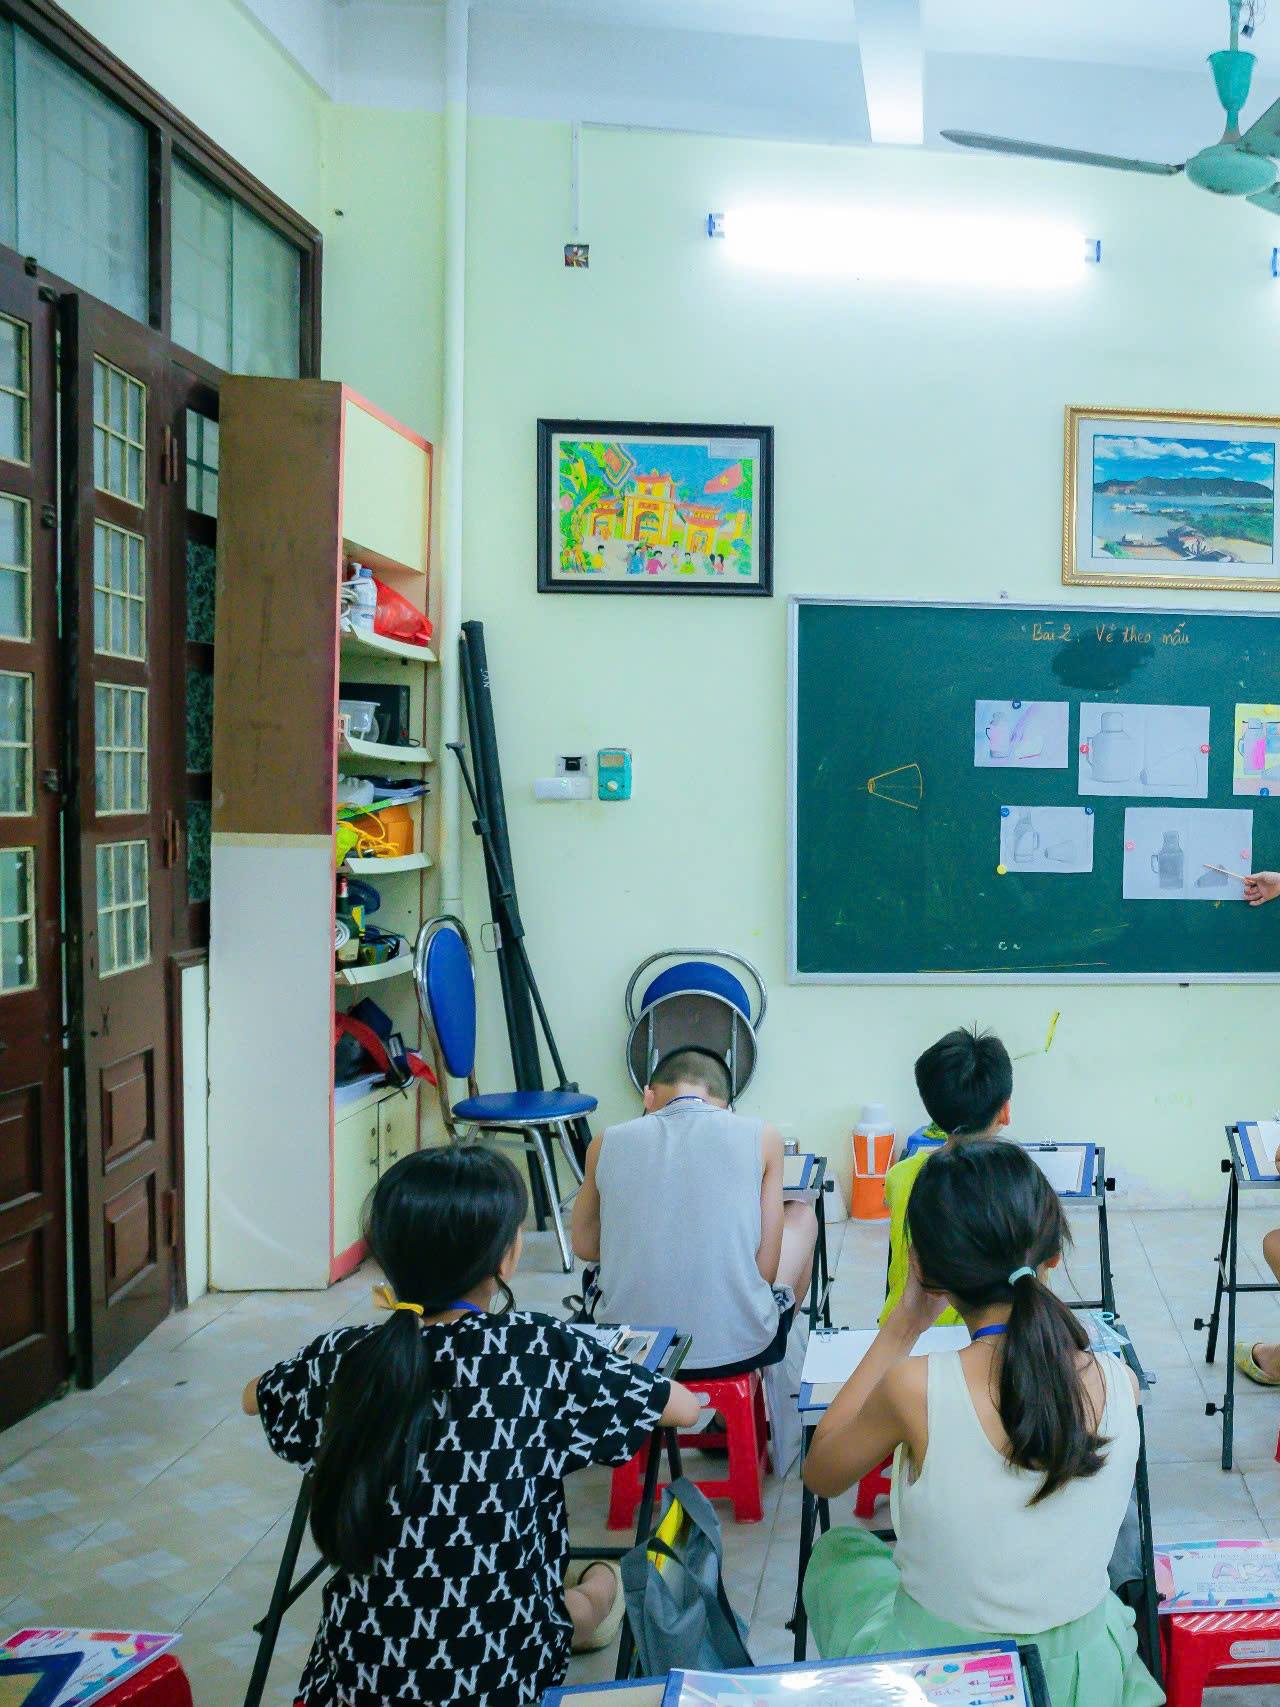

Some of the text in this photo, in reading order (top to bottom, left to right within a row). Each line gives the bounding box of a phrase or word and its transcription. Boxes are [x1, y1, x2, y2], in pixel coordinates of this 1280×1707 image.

[1122, 623, 1153, 644] theo
[1162, 621, 1191, 646] mẫu
[481, 1327, 508, 1354] N
[457, 1357, 482, 1387] N
[544, 1359, 573, 1390] N
[519, 1387, 542, 1417] N
[491, 1418, 518, 1449] N
[460, 1451, 490, 1482] N
[538, 1449, 569, 1479] N
[429, 1485, 459, 1516] N
[399, 1517, 427, 1548] N
[471, 1544, 499, 1576] N
[544, 1559, 562, 1591] N
[350, 1577, 369, 1602] N
[440, 1577, 470, 1607] N
[330, 1593, 348, 1627] N
[509, 1594, 536, 1626] N
[411, 1608, 439, 1639] N
[382, 1638, 408, 1667] N
[482, 1629, 507, 1663] N
[357, 1664, 379, 1693] N
[451, 1666, 479, 1699] N
[519, 1672, 537, 1705] N
